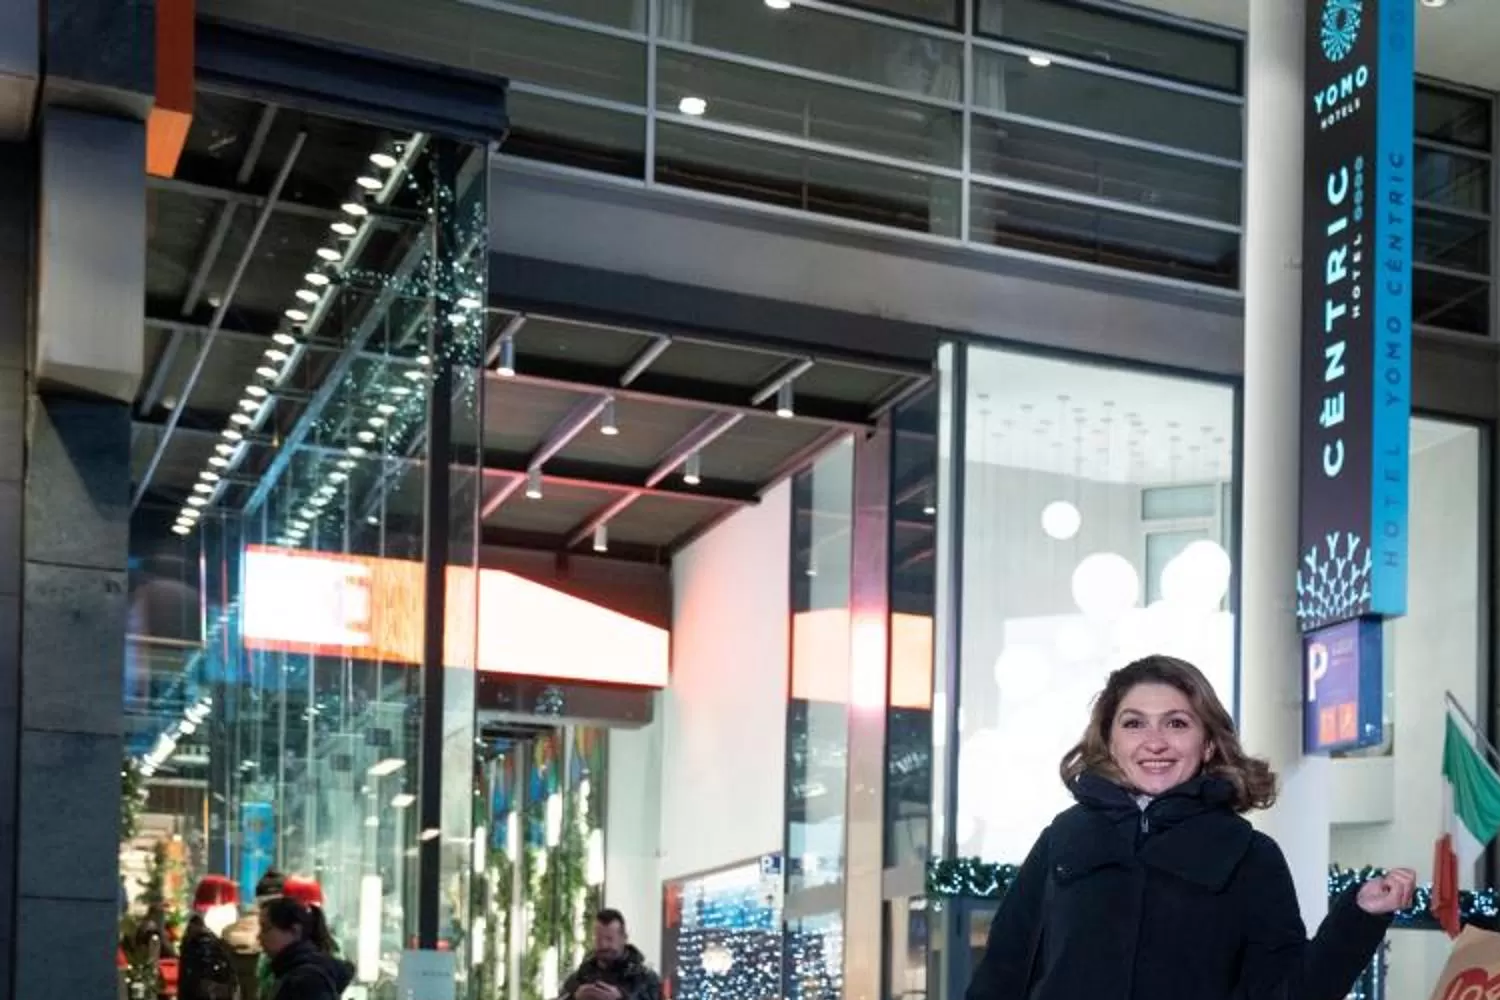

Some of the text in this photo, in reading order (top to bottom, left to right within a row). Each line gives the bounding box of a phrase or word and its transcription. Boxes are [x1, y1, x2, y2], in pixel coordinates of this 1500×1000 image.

[1314, 65, 1368, 114] YOMO
[1321, 97, 1361, 130] HOTELS
[1352, 233, 1362, 319] HOTEL
[1385, 316, 1403, 408] YOMO
[1384, 442, 1401, 568] HOTEL
[1308, 643, 1328, 702] P
